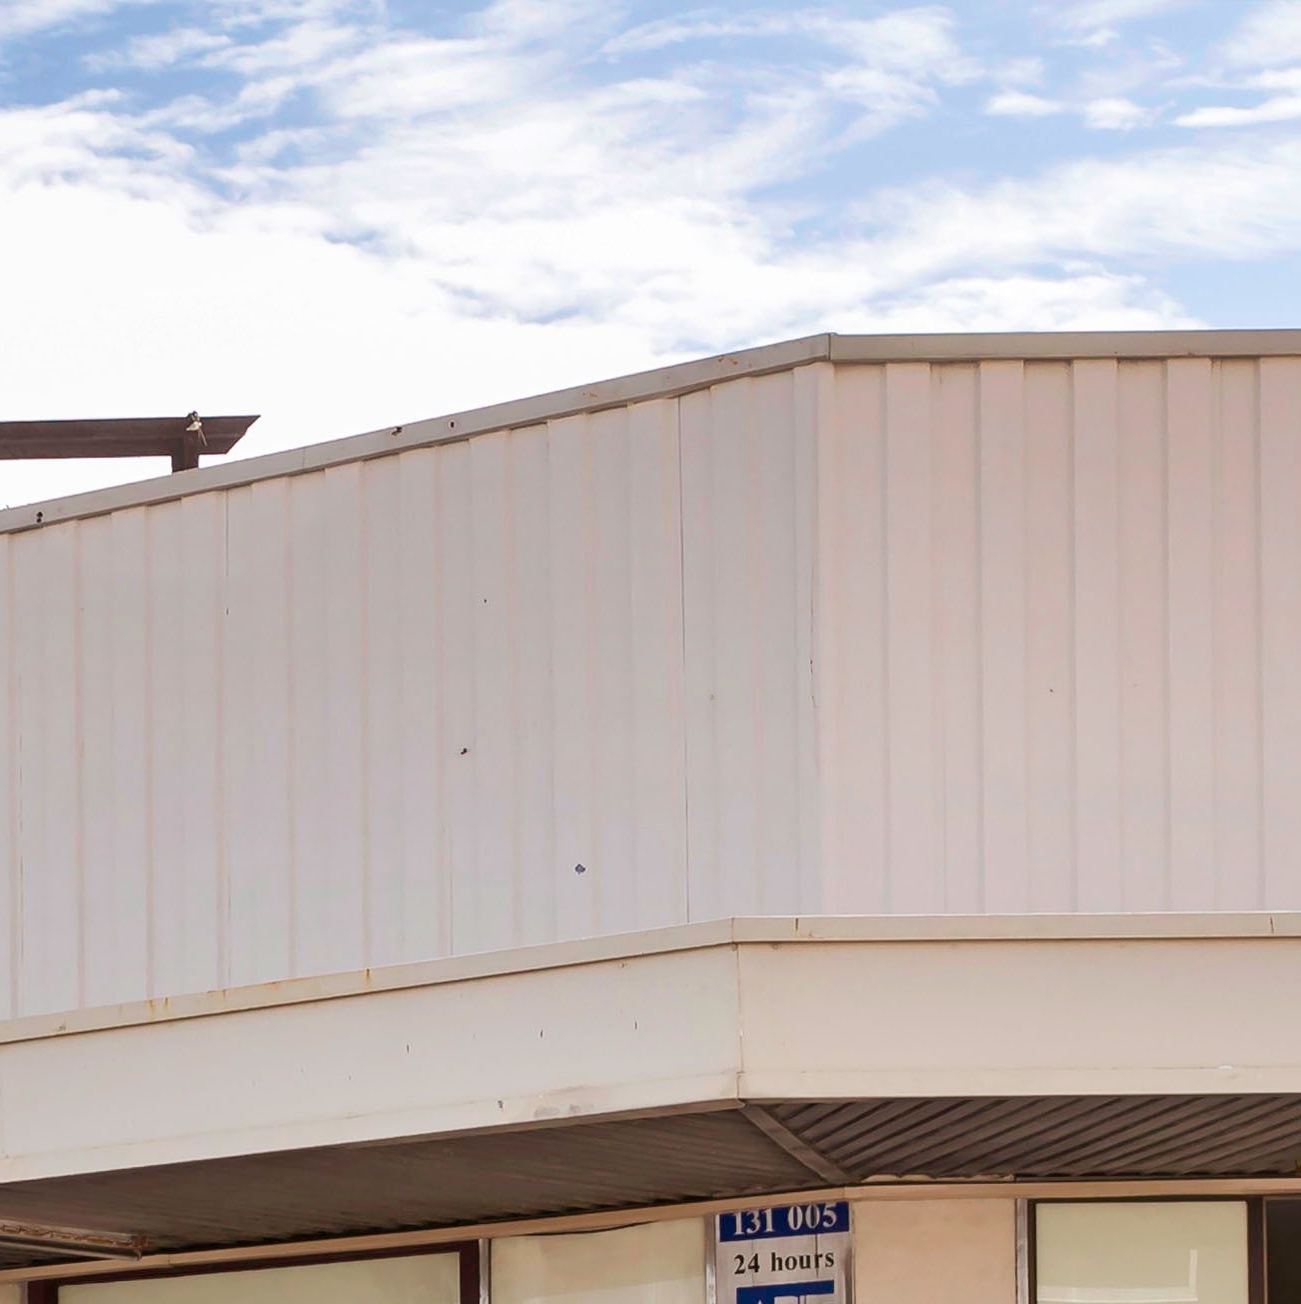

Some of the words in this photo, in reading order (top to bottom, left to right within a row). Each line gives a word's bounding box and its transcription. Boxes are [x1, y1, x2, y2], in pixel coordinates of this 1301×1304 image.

[733, 1208, 775, 1236] 131
[787, 1203, 838, 1231] 005
[734, 1252, 761, 1275] 24
[771, 1251, 835, 1273] hours
